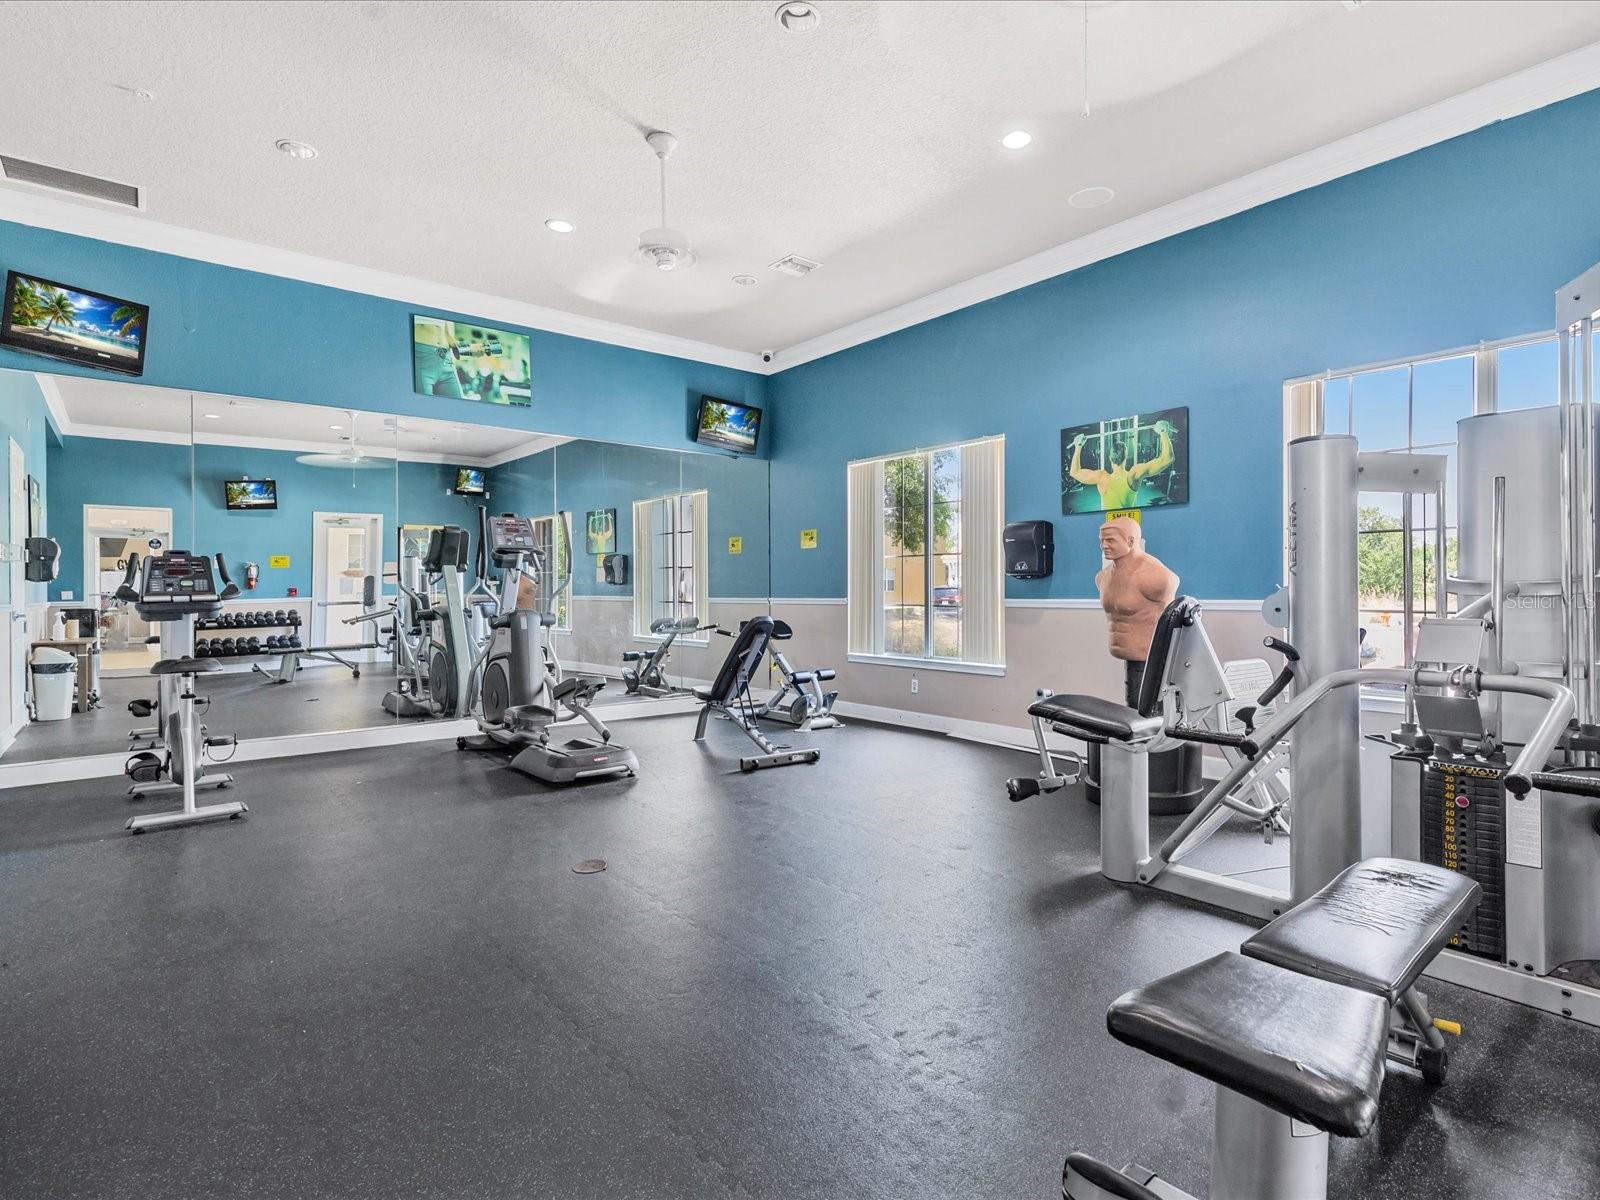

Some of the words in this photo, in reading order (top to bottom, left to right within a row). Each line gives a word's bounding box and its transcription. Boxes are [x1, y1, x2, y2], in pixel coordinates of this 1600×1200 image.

[1445, 775, 1455, 783] 20
[1445, 783, 1455, 791] 30
[1444, 792, 1455, 800] 40
[1445, 800, 1455, 808] 50
[1445, 809, 1455, 817] 60
[1445, 817, 1455, 825] 70
[1445, 825, 1455, 833] 80
[1445, 834, 1455, 842] 90
[1444, 842, 1457, 851] 100
[1444, 851, 1457, 859] 110
[1445, 860, 1457, 868] 120
